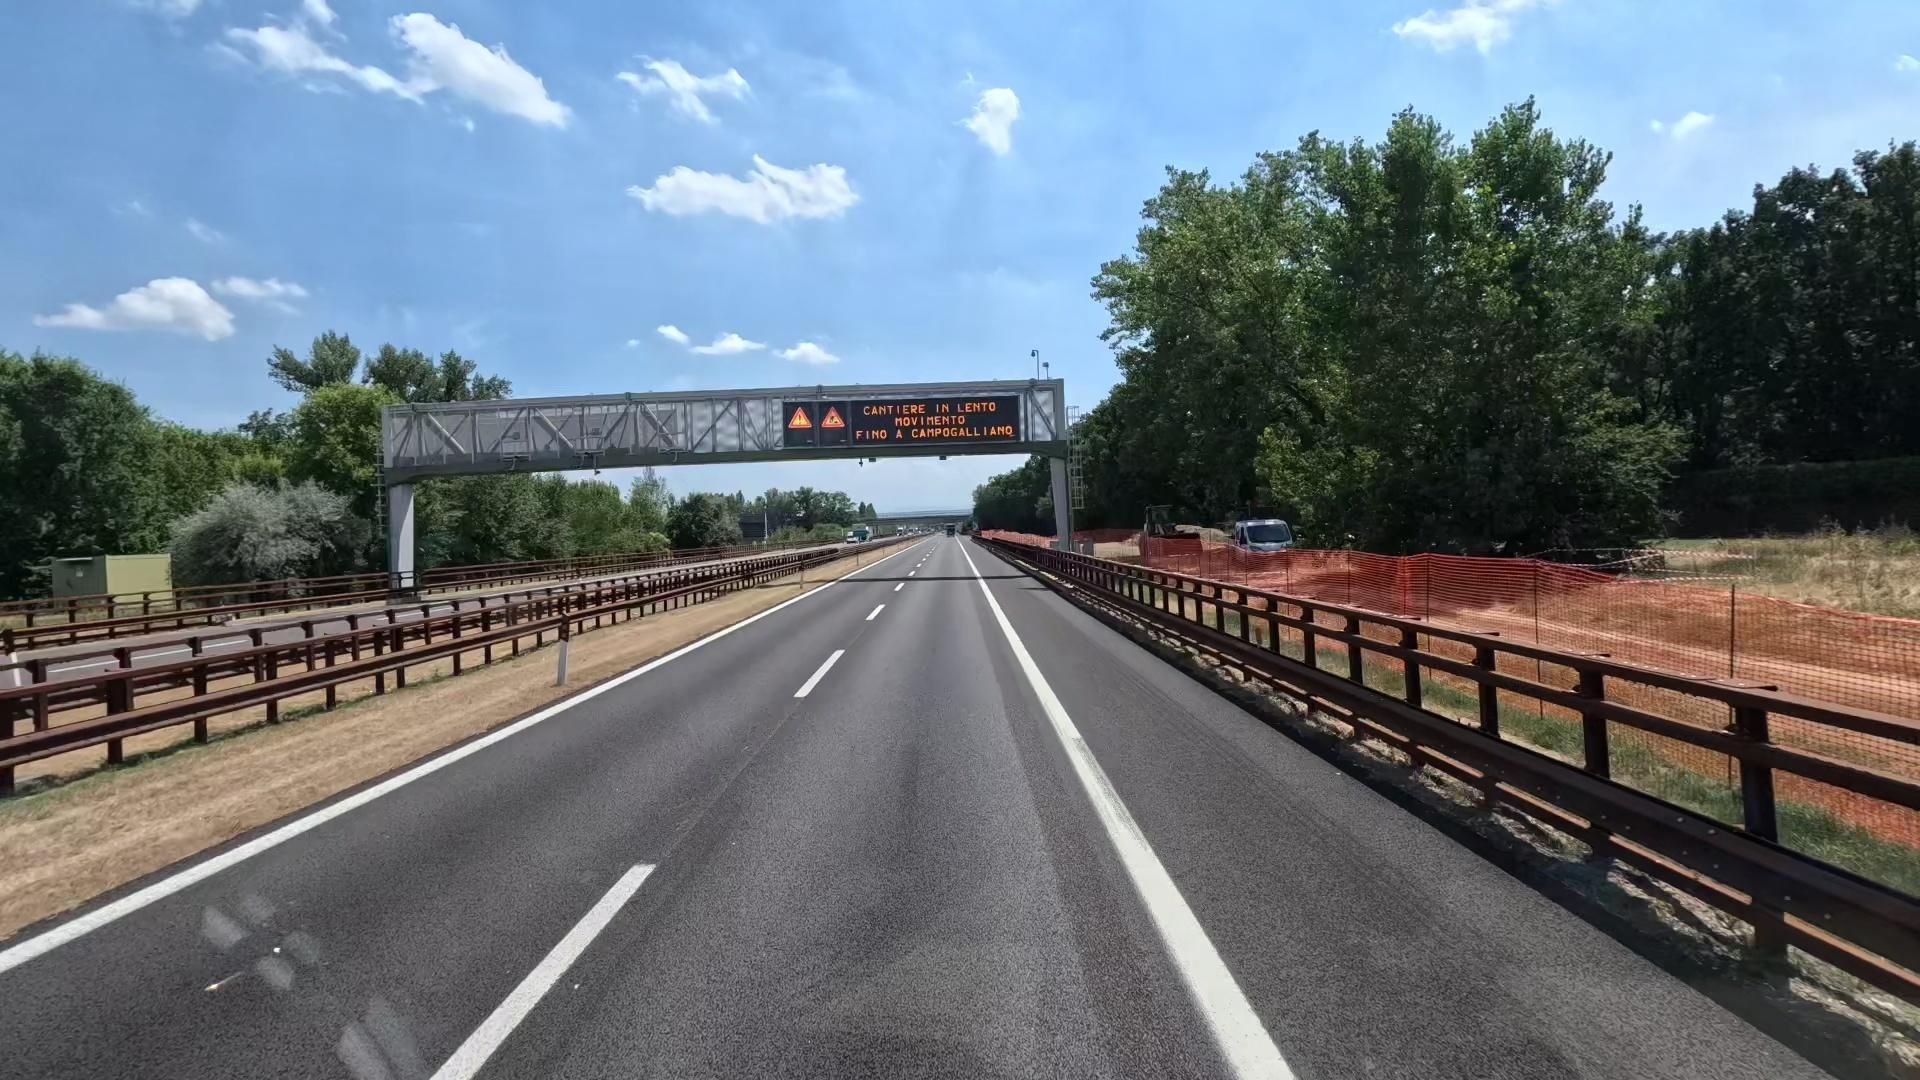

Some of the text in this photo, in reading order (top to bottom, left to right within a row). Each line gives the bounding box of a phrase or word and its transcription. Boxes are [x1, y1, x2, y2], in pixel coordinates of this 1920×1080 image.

[863, 402, 996, 416] CANTIERE IN LENTO
[895, 415, 965, 426] MOVIMENTO
[856, 425, 1013, 440] FINO A CAMPOGALLIANO
